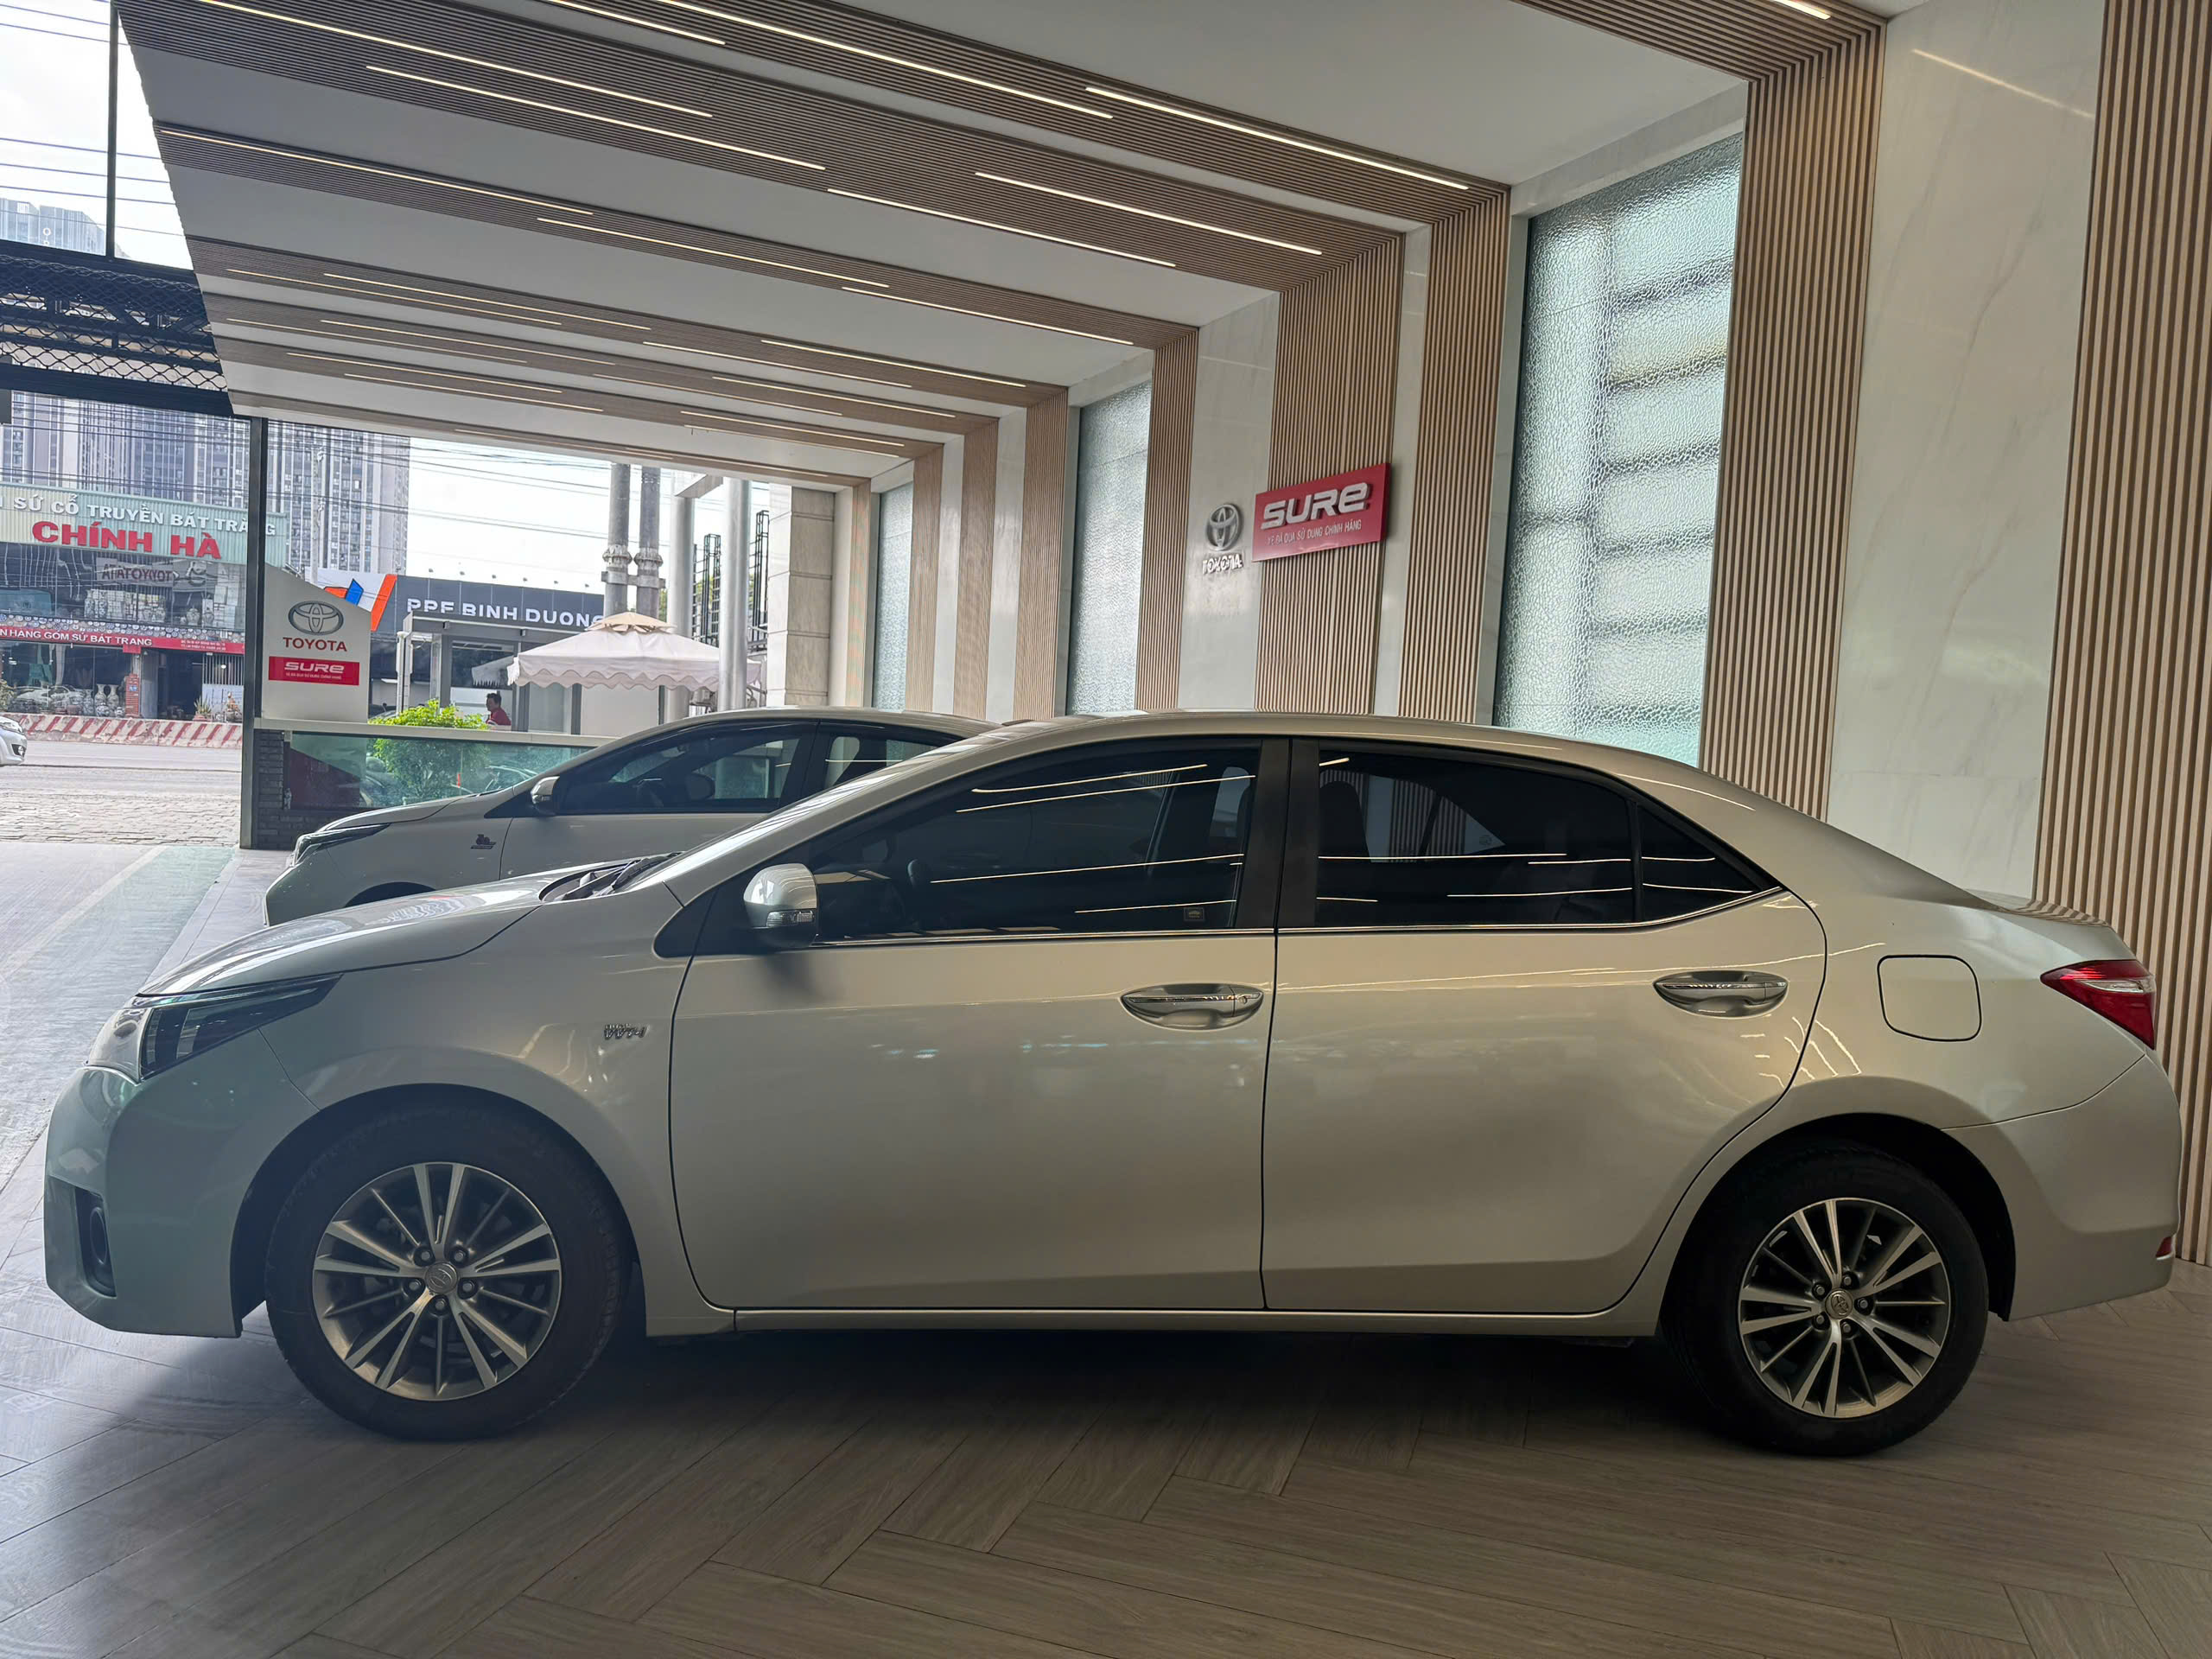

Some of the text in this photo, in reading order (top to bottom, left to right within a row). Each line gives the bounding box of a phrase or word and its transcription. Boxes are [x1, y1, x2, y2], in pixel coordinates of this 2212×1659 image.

[13, 493, 44, 512] SỨ
[51, 493, 79, 515] CỔ
[87, 504, 164, 524] TRUYỀN
[170, 512, 209, 529] BÁT
[214, 518, 276, 536] TRÀG
[32, 521, 222, 559] CHÍNH HÀ
[1202, 553, 1243, 575] TOYOTA
[407, 598, 454, 613] PPF
[462, 603, 518, 620] BINH
[91, 633, 111, 643] BÁT
[283, 637, 347, 652] TOYOTA
